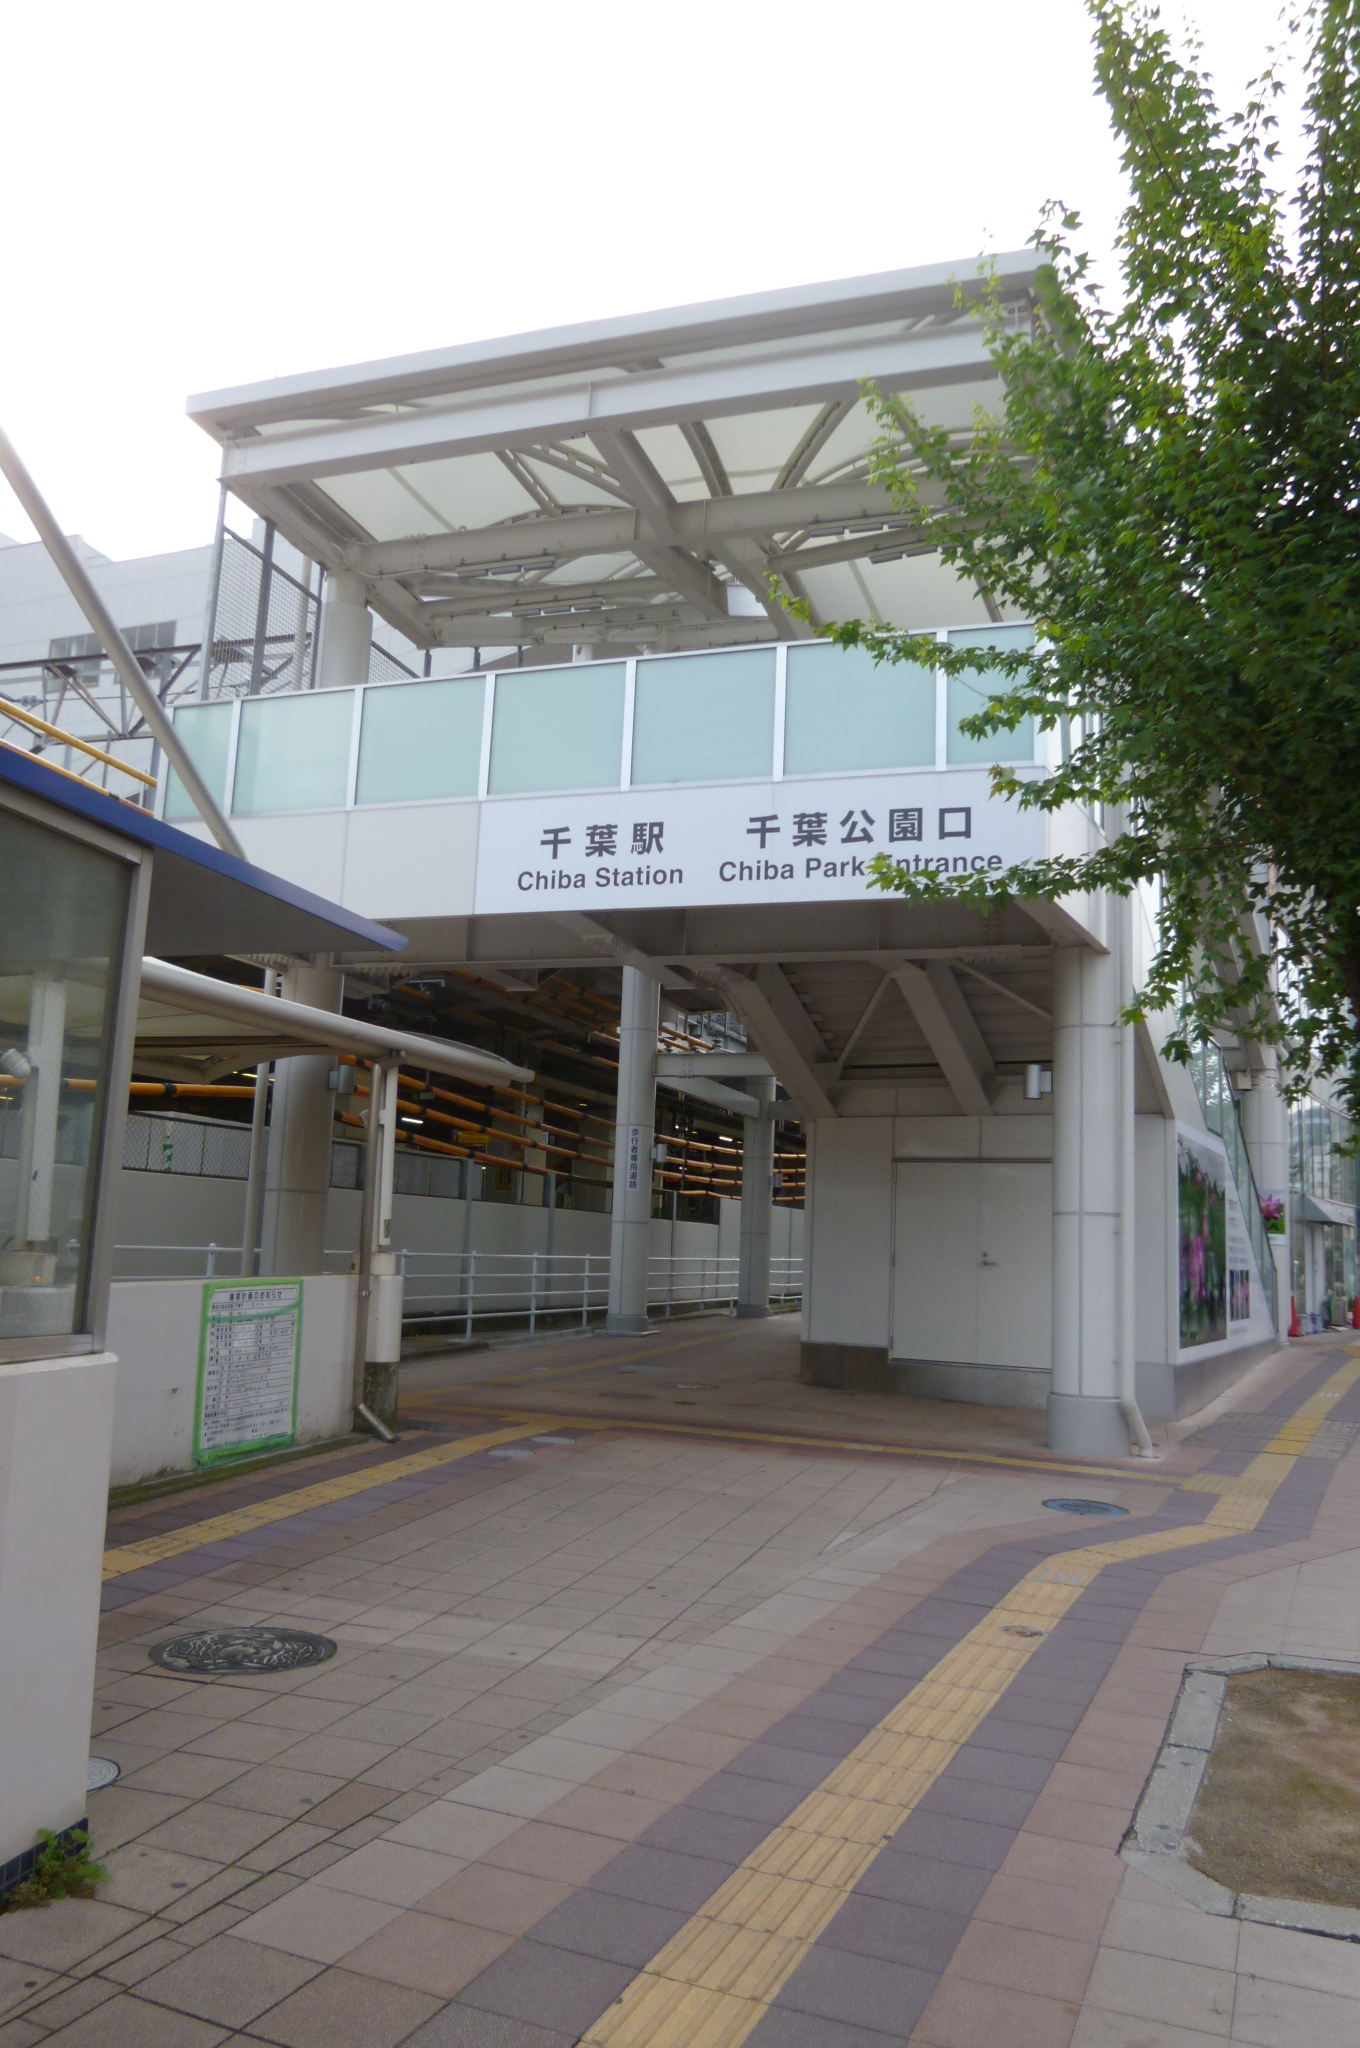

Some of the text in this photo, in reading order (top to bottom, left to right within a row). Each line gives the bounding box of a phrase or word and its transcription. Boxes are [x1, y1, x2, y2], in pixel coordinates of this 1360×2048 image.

[540, 821, 665, 860] 千葉駅
[746, 806, 972, 849] 千葉公園口
[517, 865, 684, 891] Chiba Station
[719, 859, 795, 882] Chiba
[805, 856, 866, 879] Park
[628, 1127, 640, 1189] 歩行者専用道路
